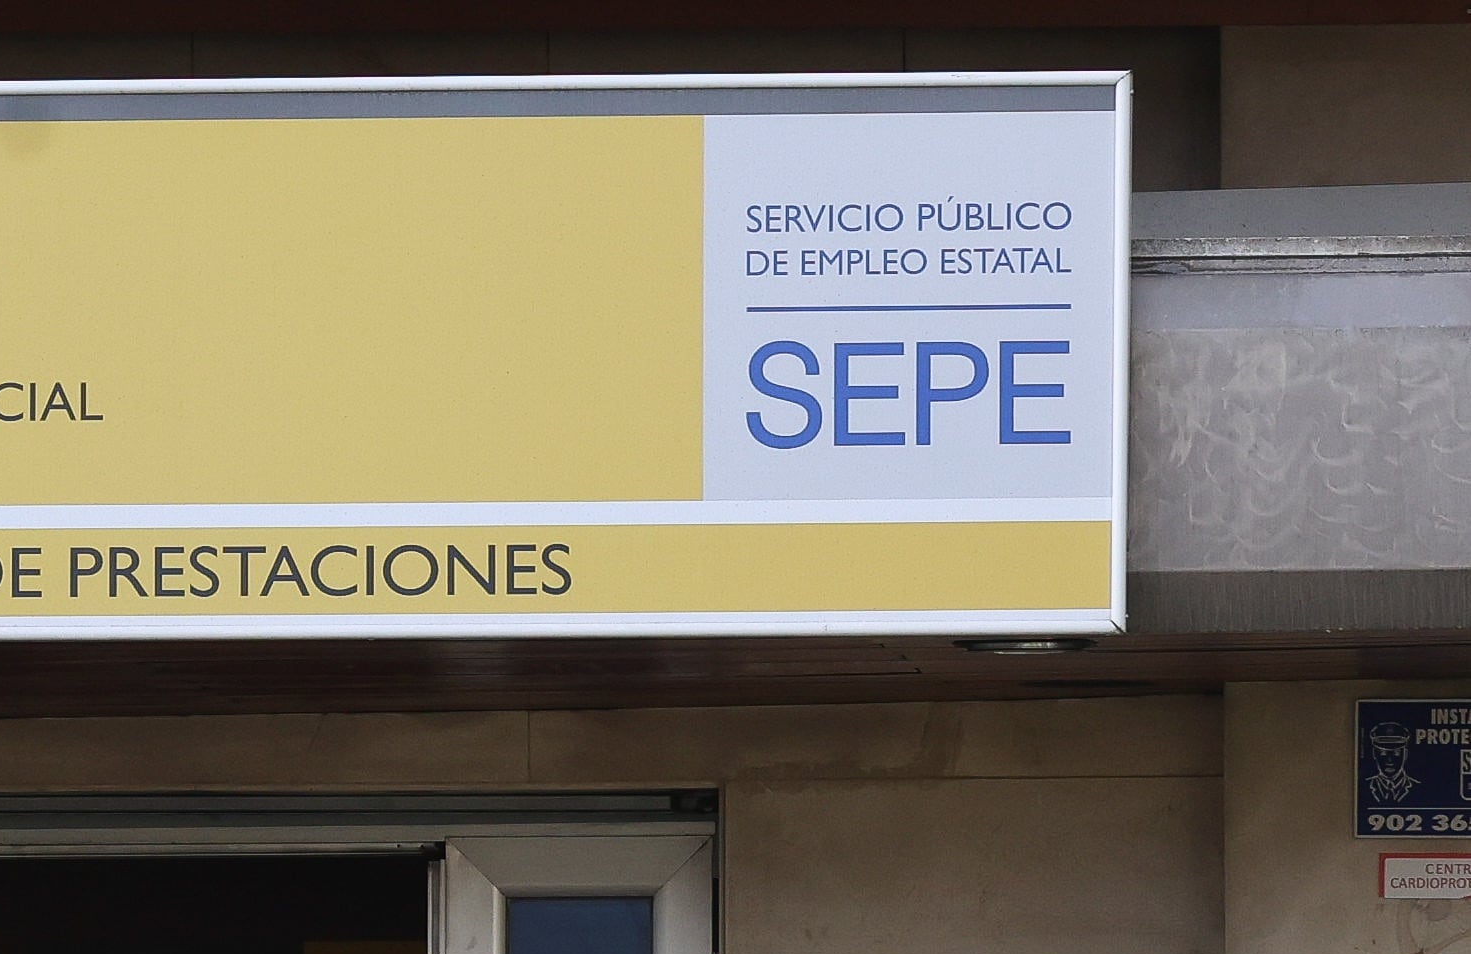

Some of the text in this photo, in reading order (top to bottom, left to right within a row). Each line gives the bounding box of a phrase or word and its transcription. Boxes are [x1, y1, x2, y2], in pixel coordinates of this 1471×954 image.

[746, 195, 1072, 233] SERVICIO PÚBLICO
[746, 247, 1072, 277] DE EMPLEO ESTATAL
[745, 340, 1072, 450] SEPE
[69, 543, 572, 598] PRESTACIONES
[1415, 728, 1471, 745] PROTE
[1368, 814, 1471, 831] 902 36
